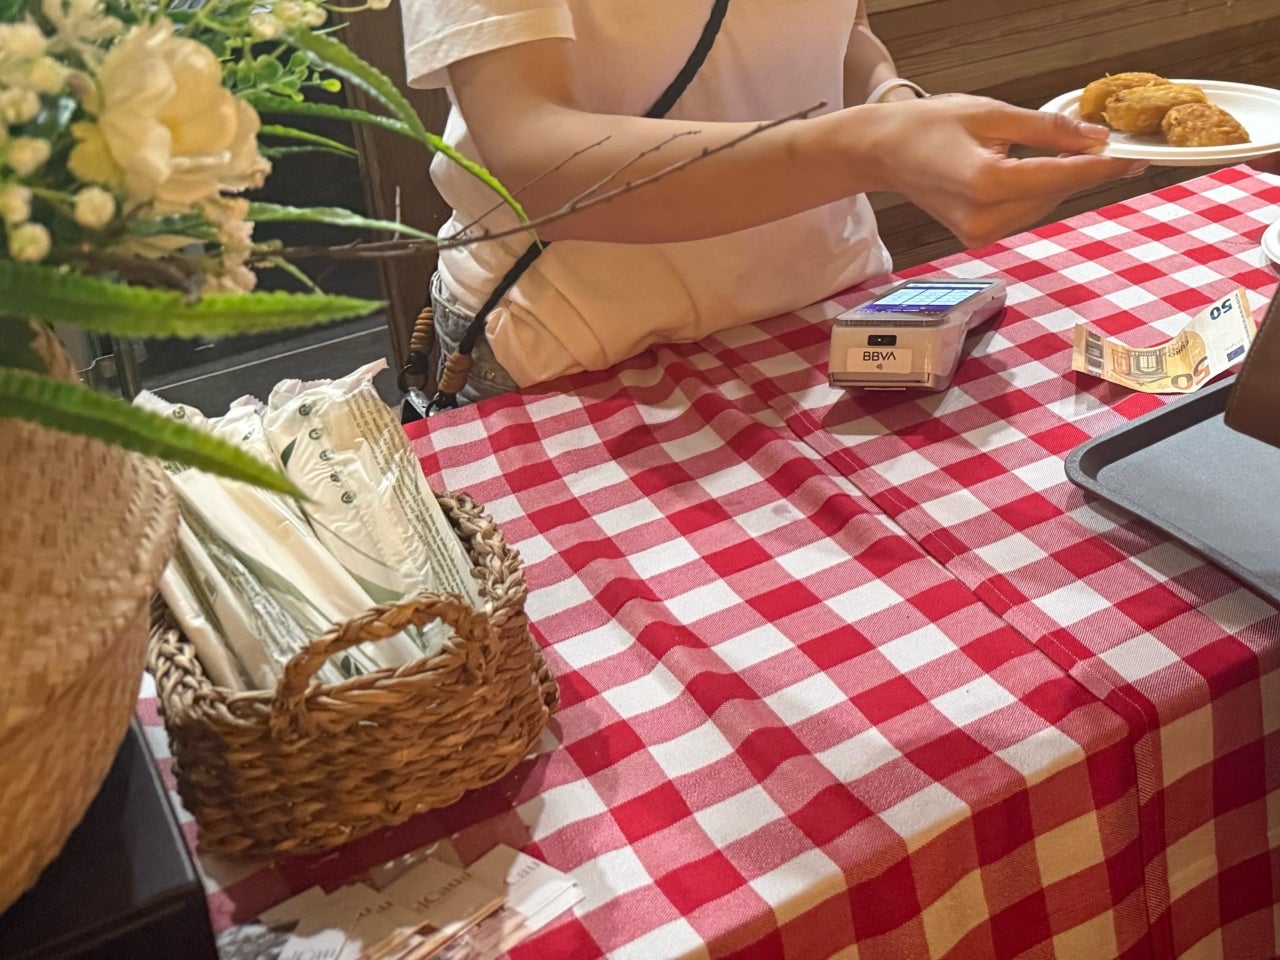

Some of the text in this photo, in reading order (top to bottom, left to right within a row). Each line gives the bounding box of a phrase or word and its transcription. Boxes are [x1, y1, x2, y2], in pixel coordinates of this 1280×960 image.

[1209, 298, 1233, 321] 50
[862, 351, 897, 362] BBVA
[1171, 355, 1211, 390] 50
